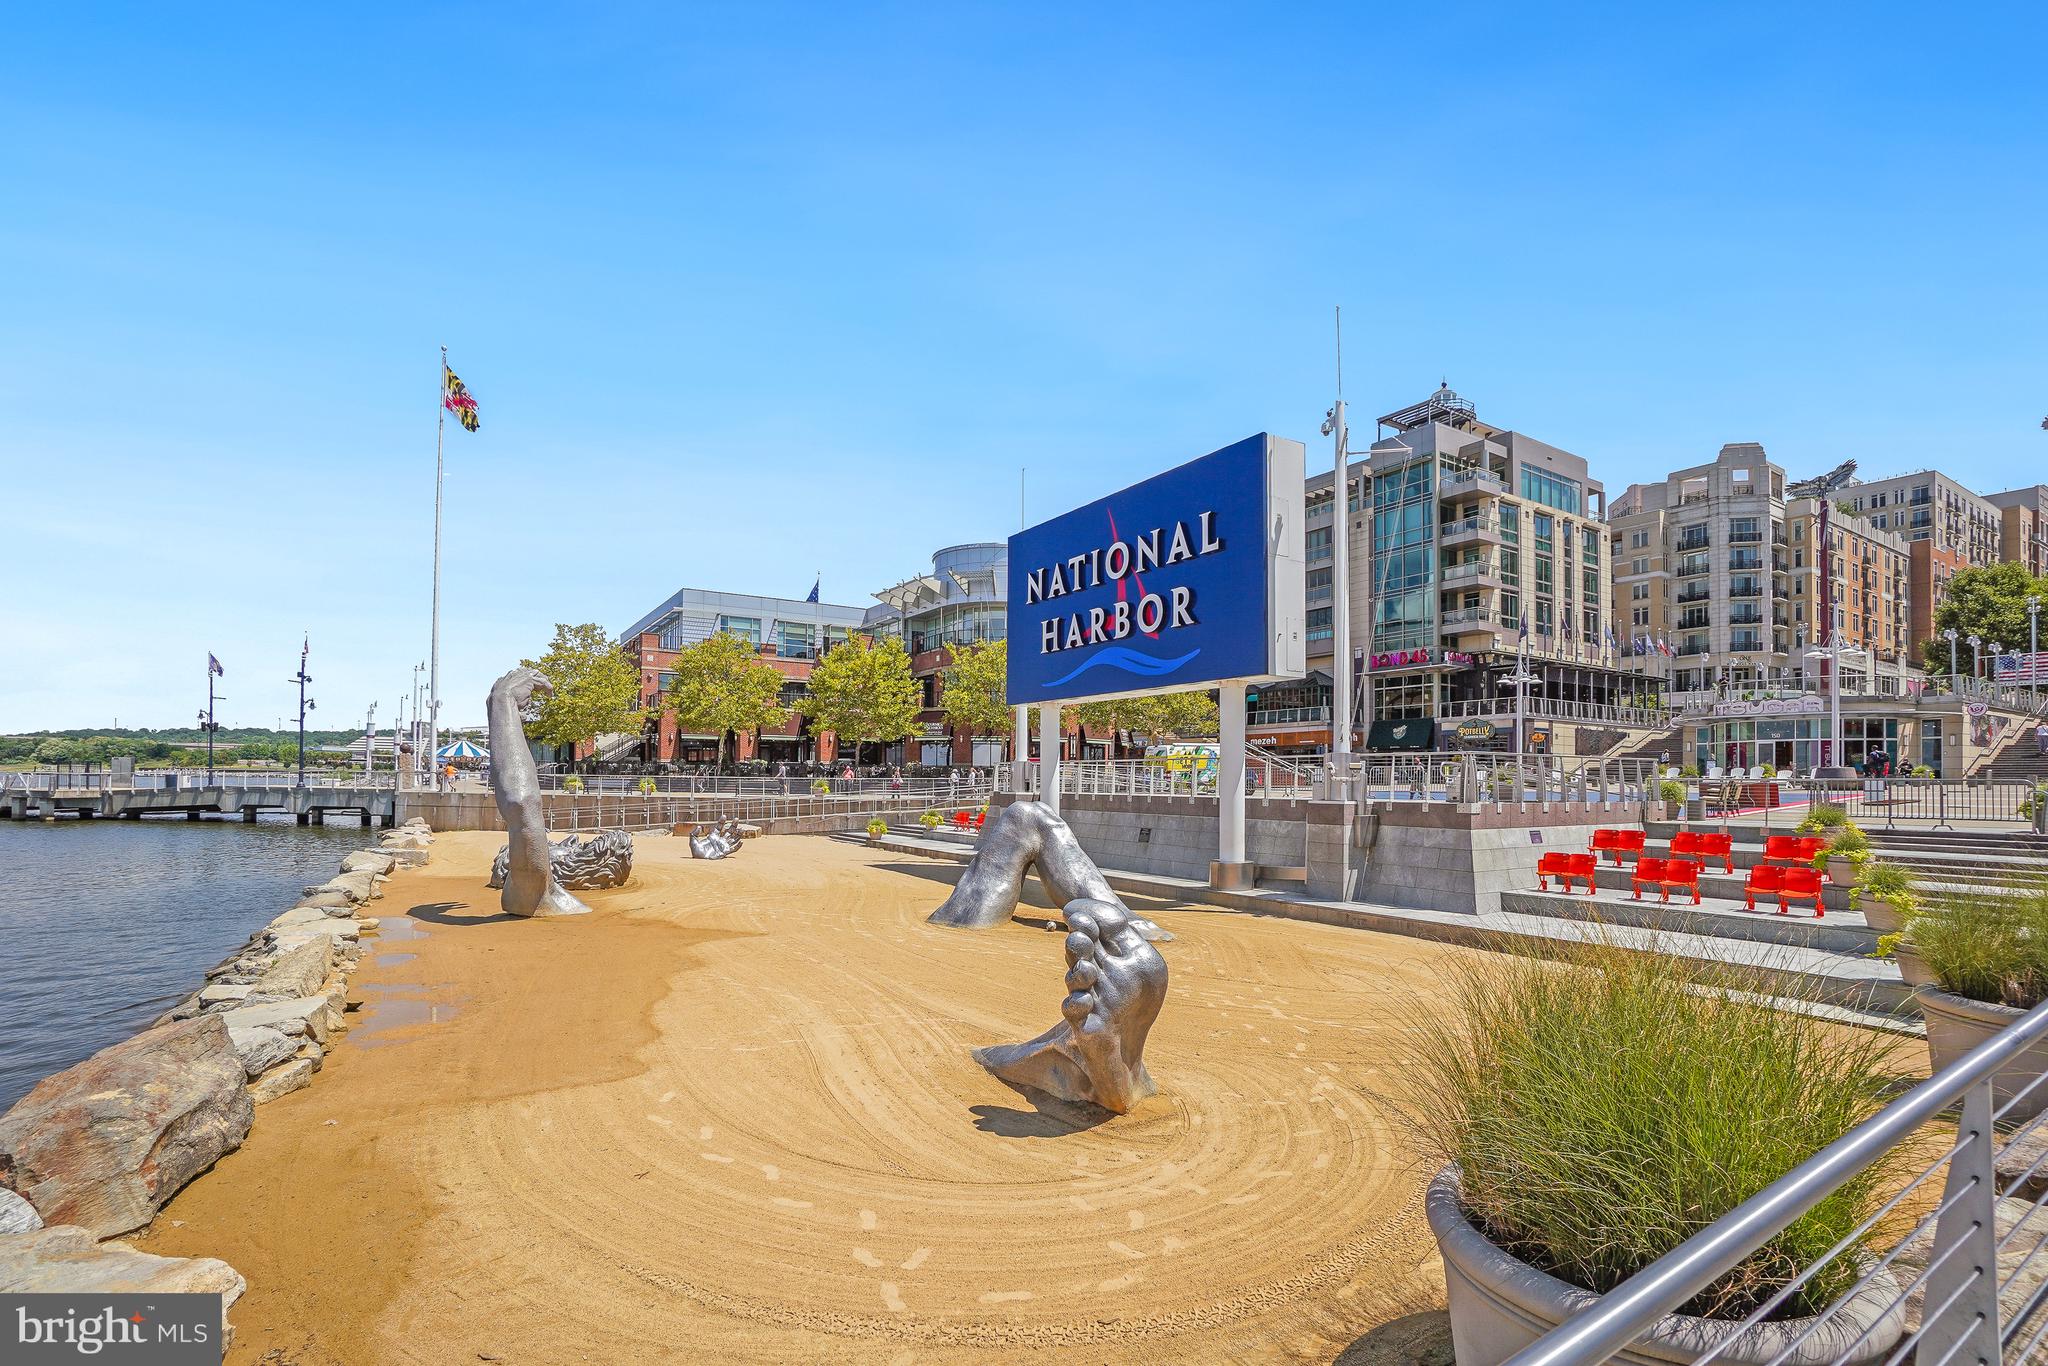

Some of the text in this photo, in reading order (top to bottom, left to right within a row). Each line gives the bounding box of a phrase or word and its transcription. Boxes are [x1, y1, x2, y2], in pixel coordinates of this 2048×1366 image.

[1025, 510, 1221, 605] NATIONAL
[1040, 586, 1197, 655] HARBOR
[1371, 650, 1409, 670] BOND
[1250, 736, 1277, 745] mezeh
[1458, 725, 1491, 737] POTBELLY
